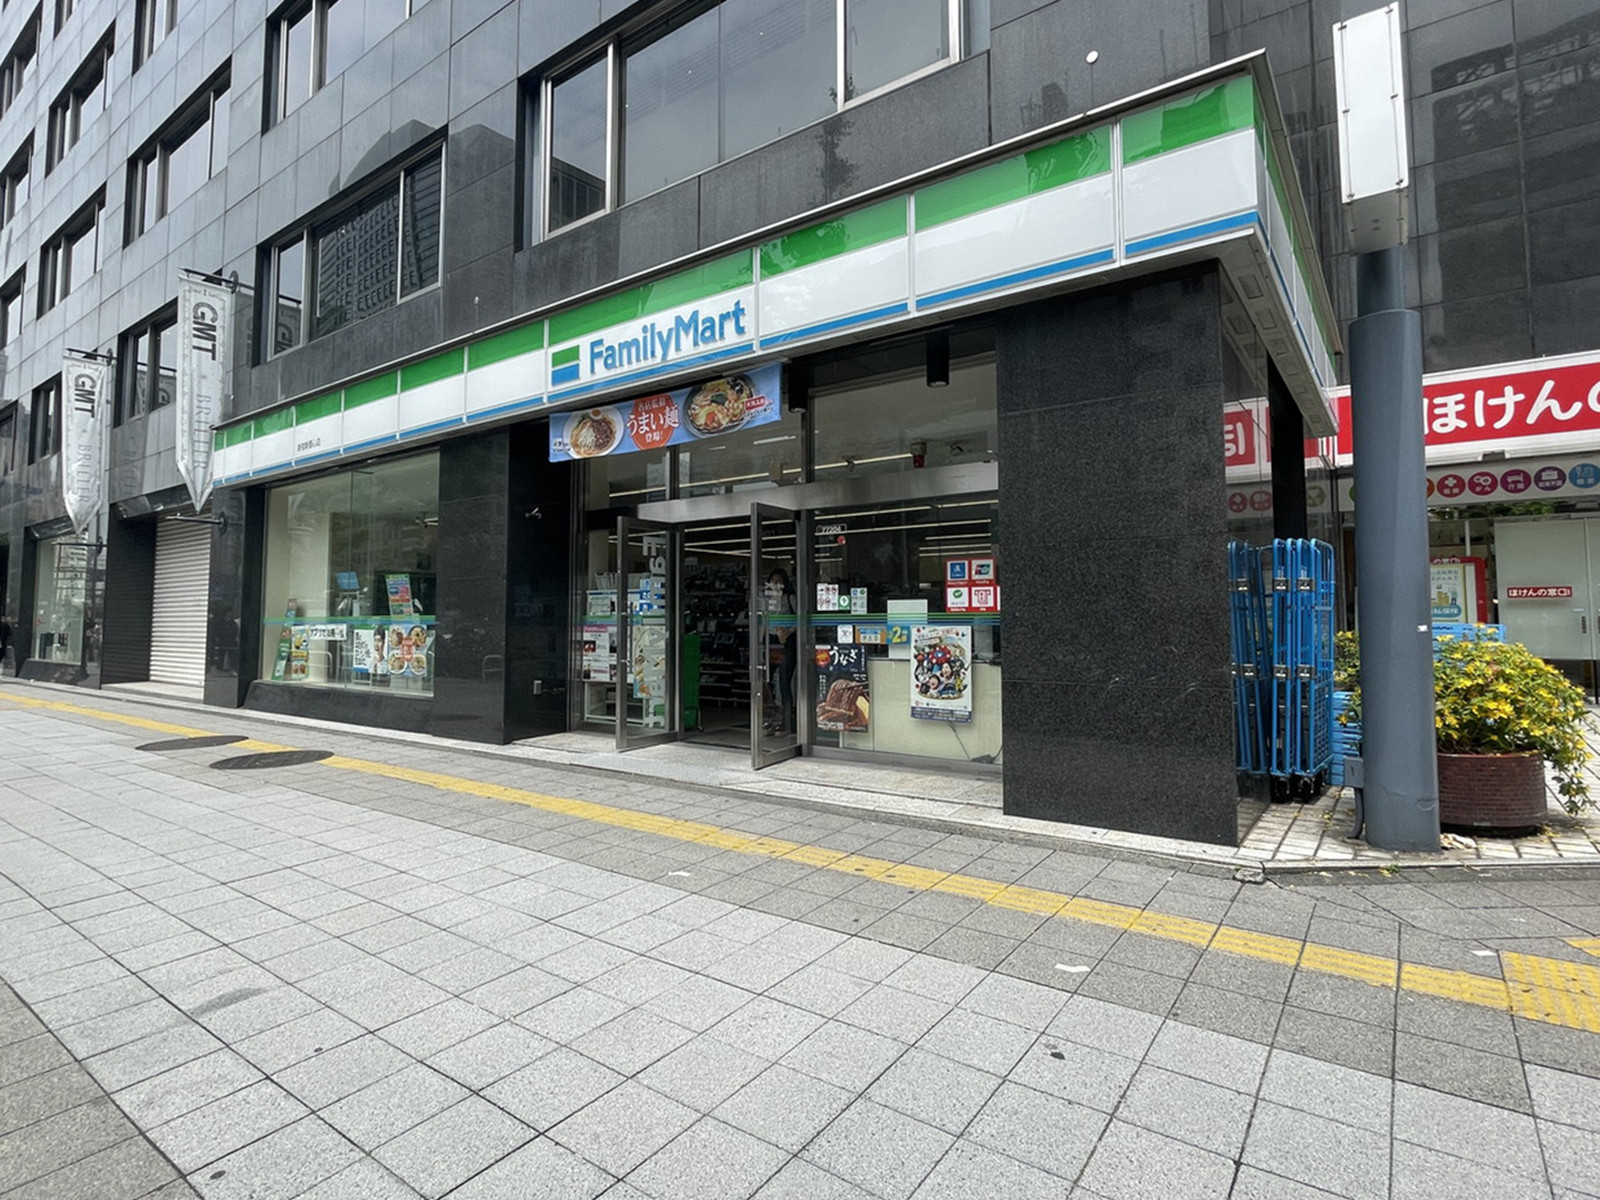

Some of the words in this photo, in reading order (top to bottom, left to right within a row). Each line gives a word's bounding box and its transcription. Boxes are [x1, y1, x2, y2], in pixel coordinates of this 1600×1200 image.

[192, 301, 218, 361] GMT
[590, 299, 746, 375] FamilyMart
[74, 373, 97, 419] GMT
[627, 402, 681, 436] うまい麺
[1423, 379, 1600, 435] ほけん
[829, 645, 858, 666] うなぎ
